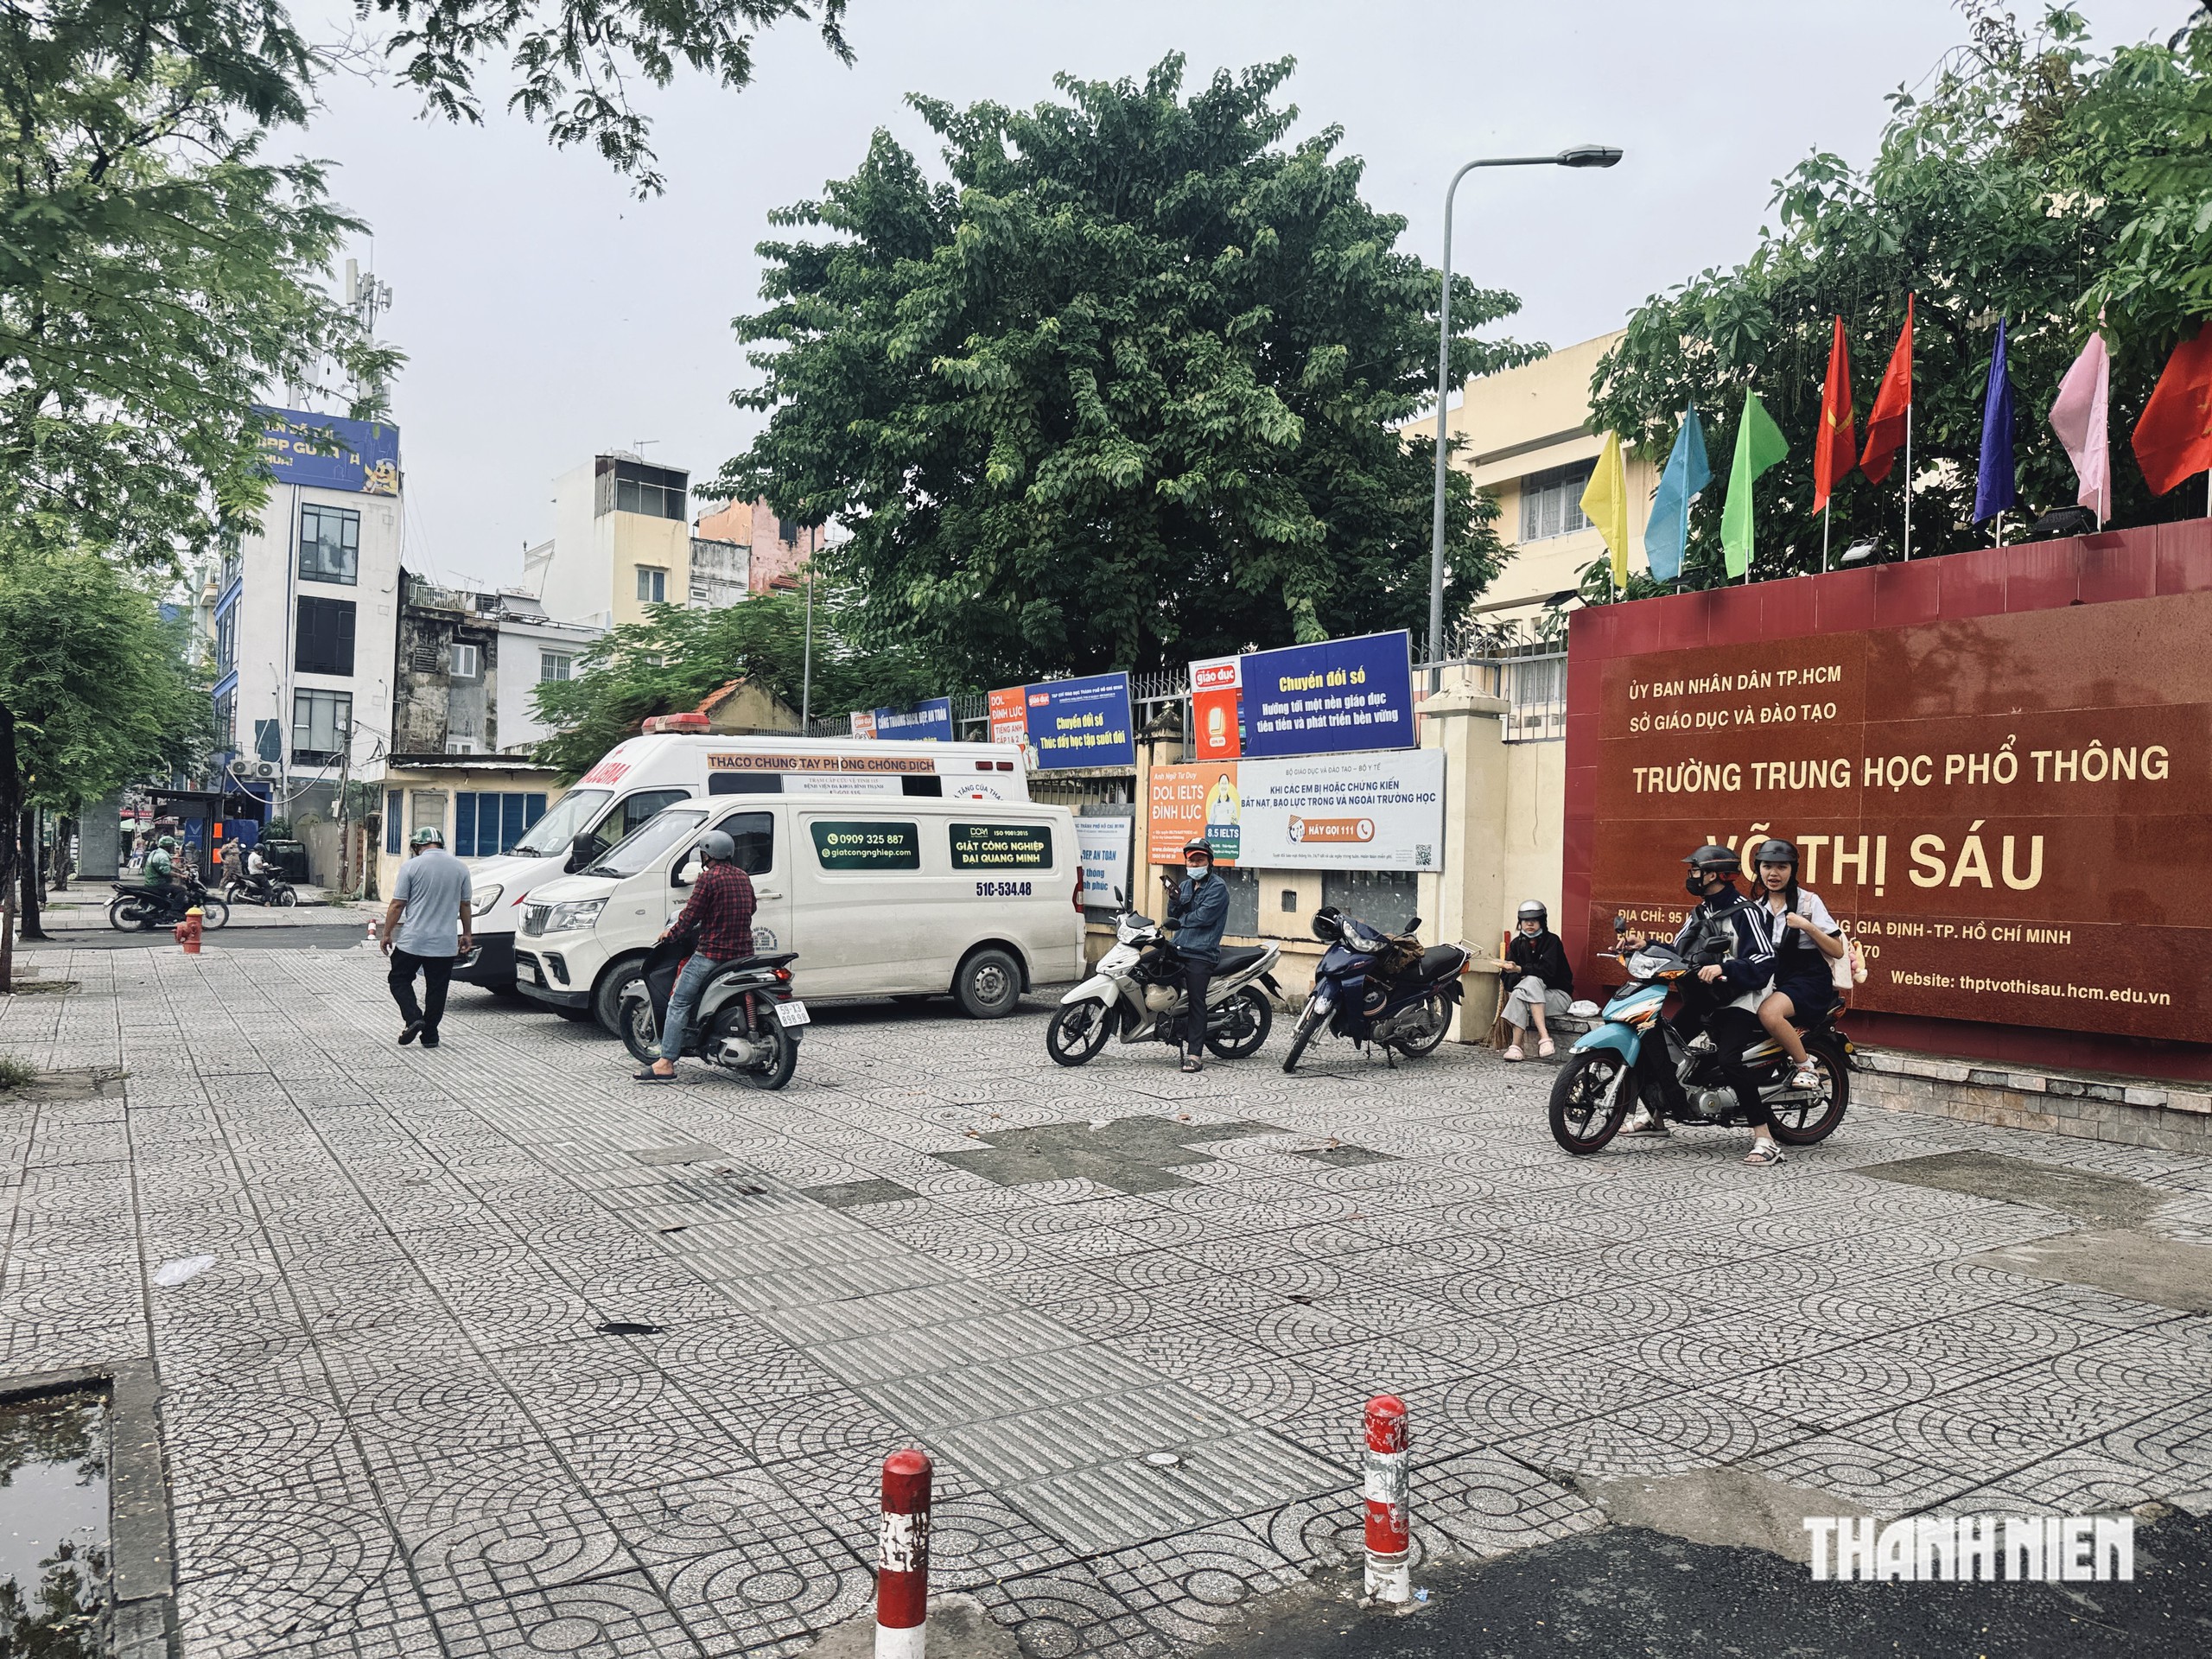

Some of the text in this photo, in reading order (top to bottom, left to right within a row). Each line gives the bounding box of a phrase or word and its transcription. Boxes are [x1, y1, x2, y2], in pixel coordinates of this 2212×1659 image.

[1197, 671, 1217, 685] giáo
[1217, 669, 1234, 683] dục
[1279, 665, 1365, 692] Chuyển đổi số
[1630, 665, 1841, 700] ỦY BAN NHÂN DÂN TP.HCM
[991, 696, 1005, 706] DOL
[1262, 692, 1386, 715] Hướng tới một nền giáo dục
[992, 706, 1023, 720] ĐÌNH LỰC
[1056, 711, 1103, 730] Chuyển đổi số
[1630, 702, 1837, 732] SỞ GIÁO DỤC VÀ ĐÀO TẠO
[1257, 709, 1398, 733] tiên tiến và phát triển bền vững
[995, 724, 1022, 734] TIẾNG ANH
[1040, 730, 1126, 749] Thúc đẩy học tập suốt đời
[709, 757, 935, 772] THACO CHUNG TAY PHÒNG CHỐNG DỊCH
[1374, 762, 1381, 771] TẾ
[1632, 734, 2169, 793] TRƯỜNG TRUNG HỌC PHỔ THÔNG
[976, 784, 988, 792] CỦA
[1153, 785, 1204, 801] DOL IELTS
[1270, 776, 1399, 795] KHI CÁC EM BỊ HOẶC CHỨNG KIẾN
[1241, 795, 1255, 807] BẮT
[1273, 798, 1289, 809] BẠO
[1290, 798, 1306, 809] LỰC
[1307, 797, 1334, 806] TRONG
[1336, 794, 1347, 805] VÀ
[1349, 793, 1375, 805] NGOÀI
[1377, 791, 1414, 804] TRƯỜNG
[1416, 792, 1436, 804] HỌC
[1152, 802, 1202, 823] ĐÌNH LỰC
[1207, 828, 1219, 838] 8.5
[1219, 829, 1239, 838] IELTS
[1308, 823, 1354, 836] HÃY GỌI 111
[840, 834, 904, 844] 0909 325 887
[956, 840, 1045, 852] GIẶT CÔNG NGHIỆP
[831, 849, 912, 858] giatcongnghiep.com
[963, 854, 1040, 864] ĐẠI QUANG MINH
[1093, 850, 1100, 861] AN
[1103, 849, 1116, 861] TOÀN
[1796, 835, 1887, 897] THỊ
[1909, 819, 2044, 890] SÁU
[976, 882, 1032, 896] 51C-534.48
[1092, 880, 1109, 891] phúc
[1618, 909, 1637, 923] ĐỊA
[1640, 906, 1664, 923] CHỈ:
[1669, 912, 1682, 924] 95
[1856, 920, 1882, 935] GIA
[1962, 920, 1986, 940] HỒ
[1991, 924, 2021, 942] CHÍ
[2026, 928, 2071, 944] MINH
[1648, 931, 1675, 944] THO
[1891, 970, 2171, 1006] Website: thptvothisau.hcm.edu.vn
